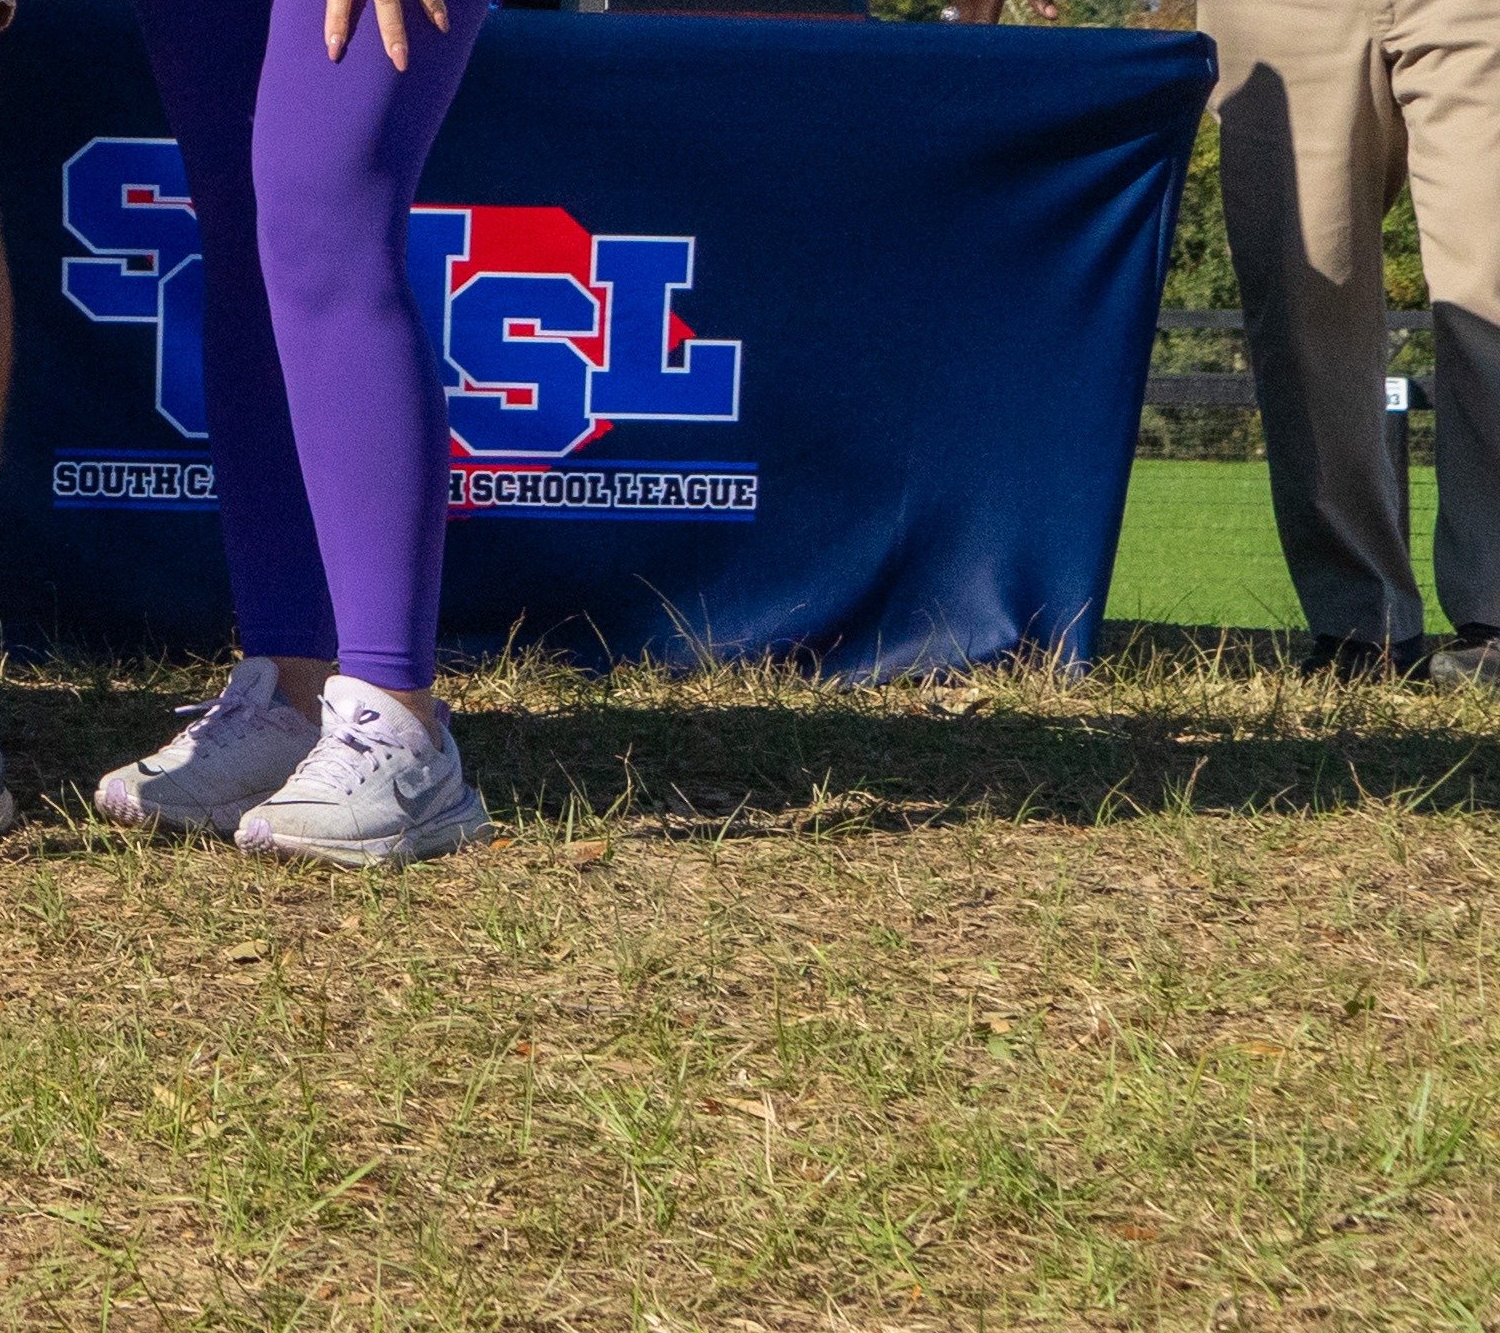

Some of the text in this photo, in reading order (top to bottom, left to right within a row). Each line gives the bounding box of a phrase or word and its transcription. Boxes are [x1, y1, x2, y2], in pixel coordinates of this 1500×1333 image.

[62, 137, 742, 457] SSL
[53, 461, 180, 498] SOUTH
[469, 471, 611, 507] SCHOOL
[614, 473, 757, 510] LEAGUE
